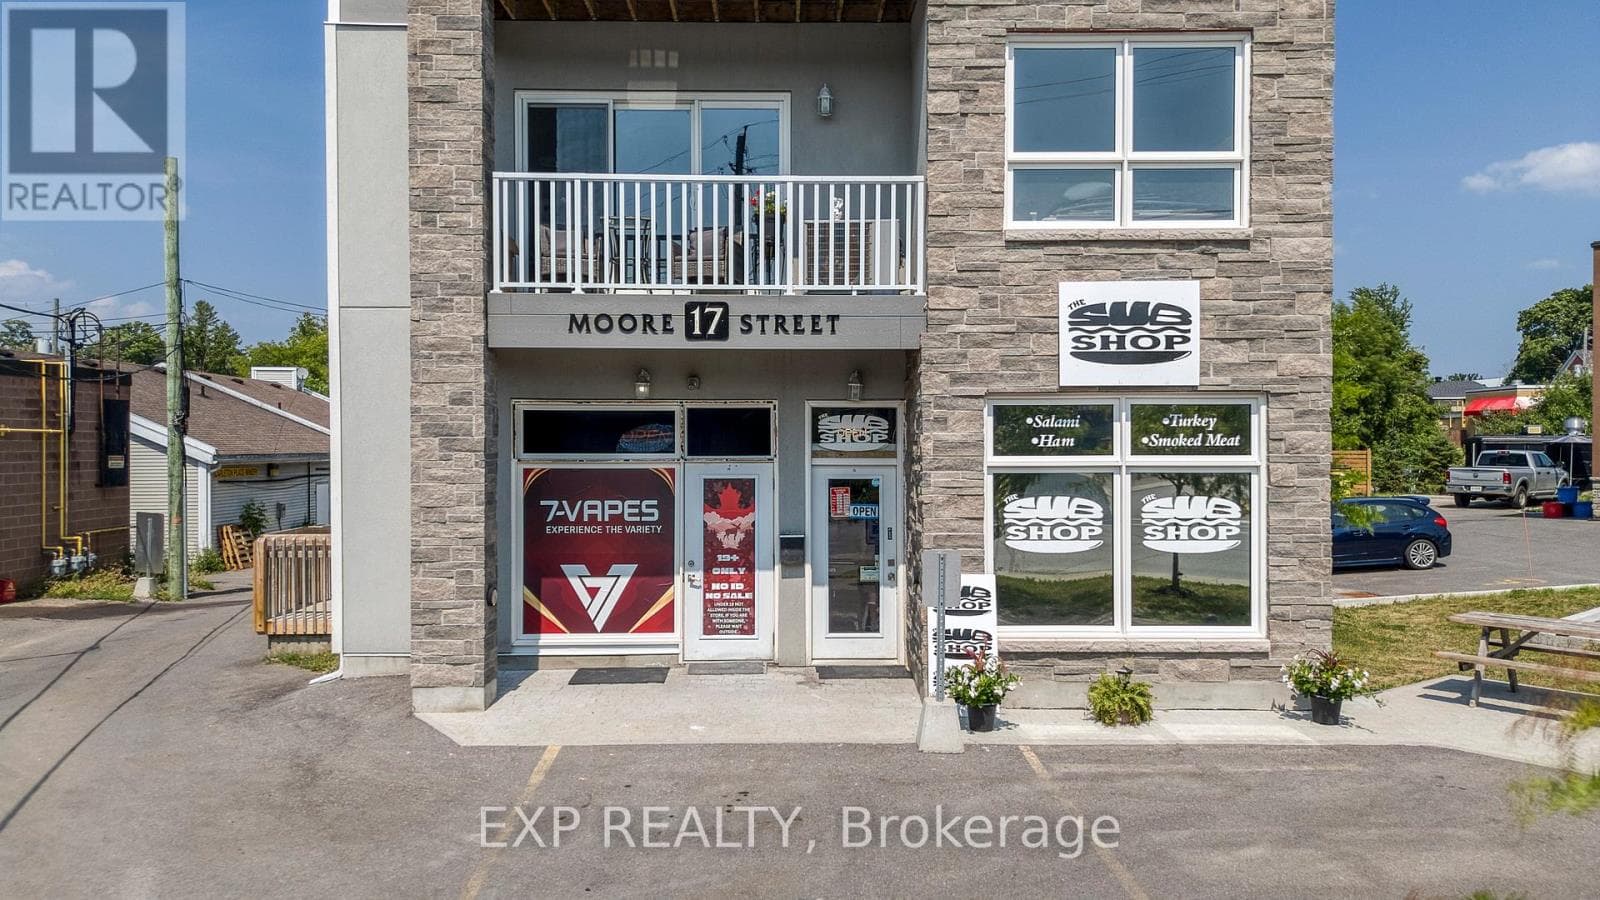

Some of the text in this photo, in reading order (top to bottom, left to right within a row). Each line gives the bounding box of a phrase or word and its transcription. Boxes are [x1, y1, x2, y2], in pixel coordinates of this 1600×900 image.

[1067, 299, 1086, 310] THE
[568, 305, 840, 336] MOORE 17 STREET
[1067, 301, 1192, 326] SUB
[1071, 335, 1191, 350] SHOP
[818, 415, 889, 429] SUB
[820, 433, 888, 443] SHOP
[1205, 433, 1240, 447] Meat
[1004, 493, 1018, 504] THE
[1141, 493, 1157, 504] THE
[540, 500, 659, 522] 7-VAPES
[852, 506, 877, 516] OPEN
[1003, 496, 1104, 519] SUB
[1141, 496, 1241, 519] SUB
[546, 525, 662, 534] EXPERIENCE THE VARIETY
[1006, 525, 1103, 540] SHOP
[1144, 525, 1240, 540] SHOP
[711, 567, 746, 575] ONLY
[711, 582, 729, 590] NO
[730, 582, 745, 590] ID
